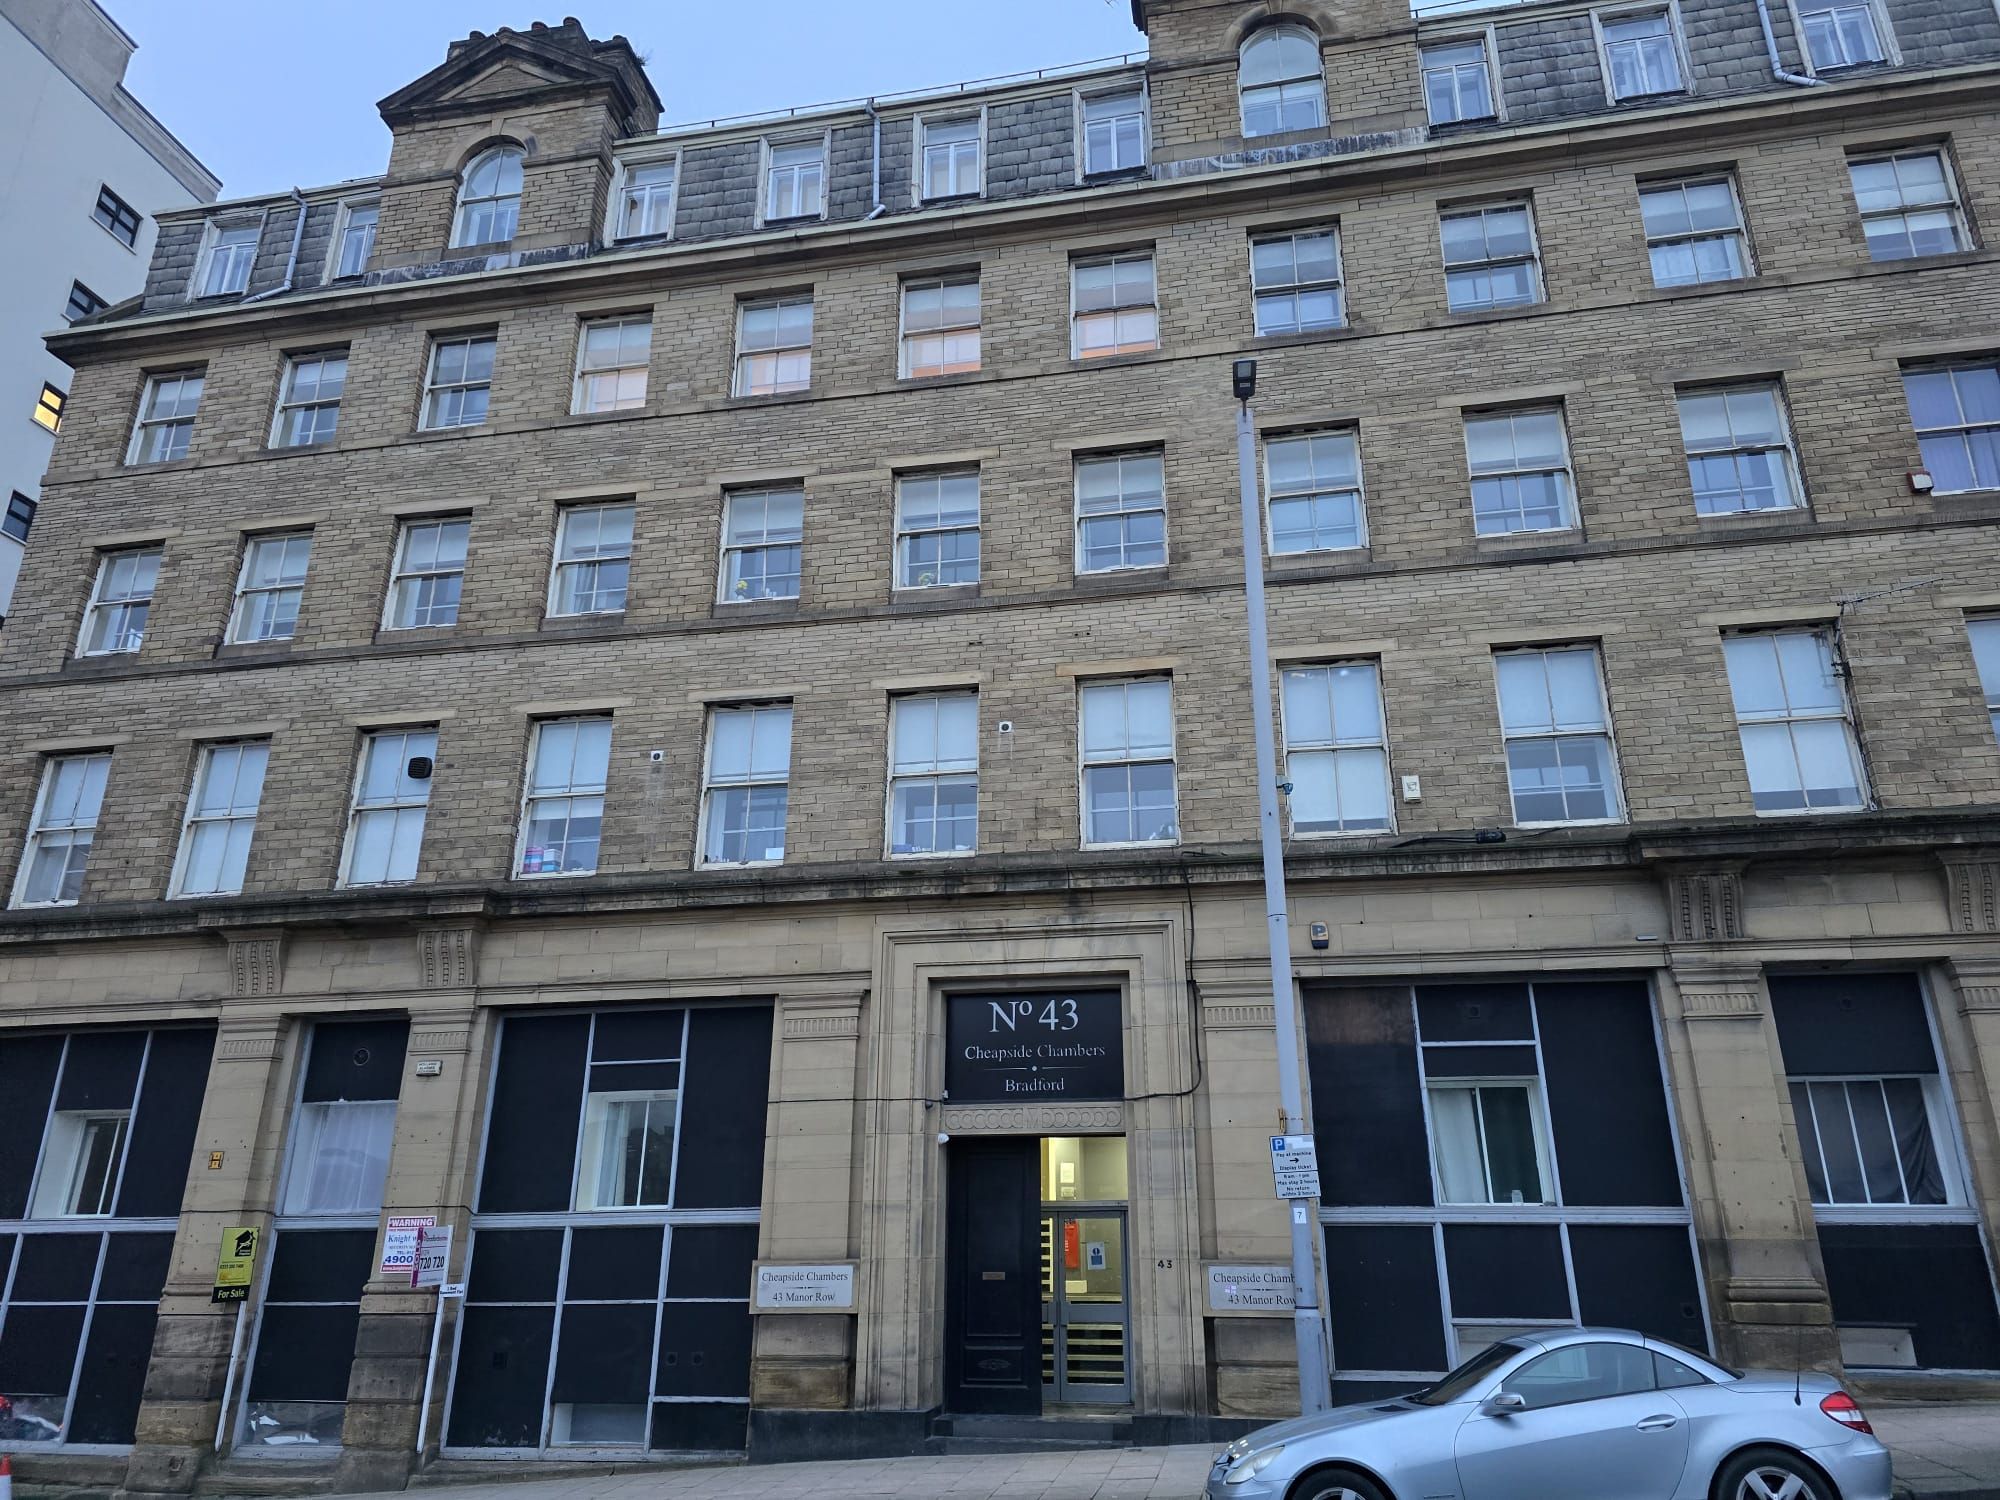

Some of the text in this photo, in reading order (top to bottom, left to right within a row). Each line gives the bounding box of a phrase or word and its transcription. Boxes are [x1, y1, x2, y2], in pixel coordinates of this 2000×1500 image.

[1038, 999, 1079, 1031] 43
[965, 1043, 1105, 1062] Cheapside Chambers
[1005, 1077, 1065, 1092] Bradford
[1274, 1139, 1284, 1150] P
[1296, 1211, 1303, 1219] 7
[391, 1218, 433, 1227] WARNING
[388, 1234, 411, 1244] Knight
[384, 1255, 414, 1264] 4900
[420, 1257, 432, 1270] 720
[433, 1256, 445, 1269] 720
[1157, 1260, 1173, 1269] 43
[761, 1271, 848, 1283] Cheapside Chambers
[1213, 1272, 1295, 1285] Cheapside Chamb
[218, 1288, 245, 1299] For Sale
[772, 1292, 835, 1301] 43 Manor Row
[1228, 1295, 1296, 1304] 43 Manor Row
